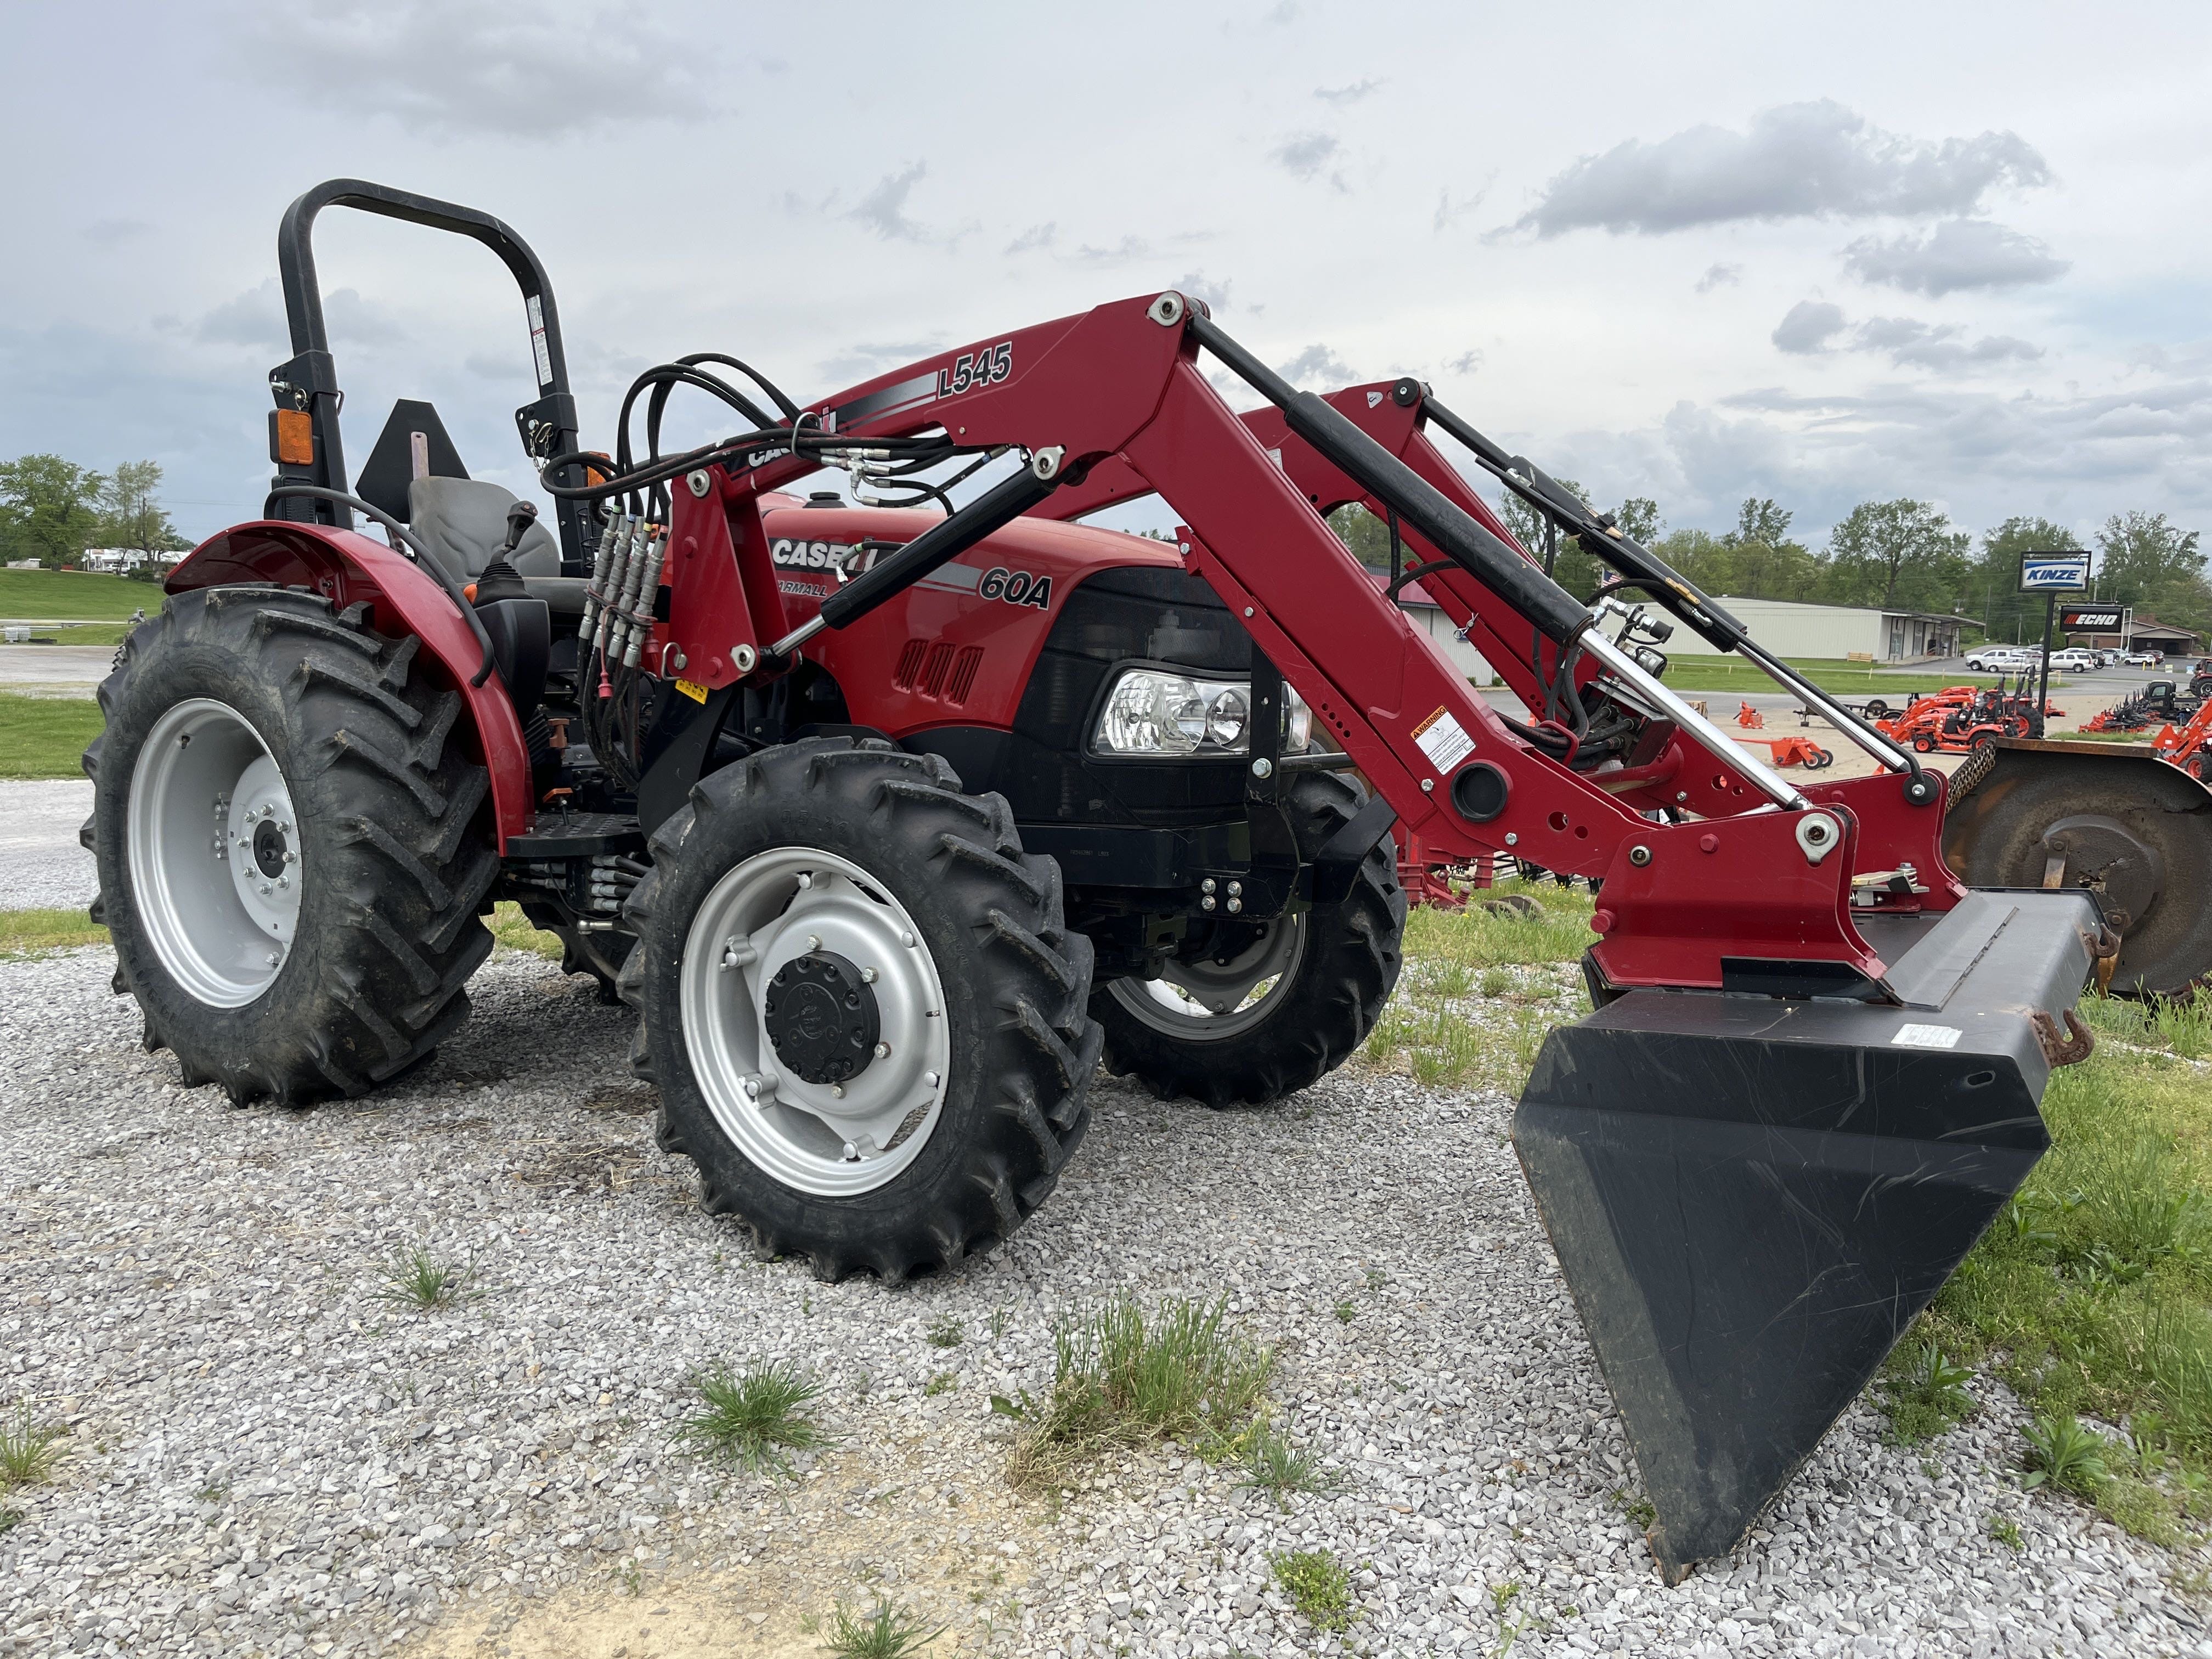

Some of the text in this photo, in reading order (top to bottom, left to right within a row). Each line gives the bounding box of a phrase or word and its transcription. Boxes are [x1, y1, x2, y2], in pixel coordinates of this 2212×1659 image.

[938, 341, 1012, 399] L545
[772, 539, 849, 569] CASE
[2027, 569, 2081, 580] KINZE
[777, 579, 828, 598] ARMALL
[979, 567, 1052, 611] 60A
[2075, 614, 2118, 626] ECHO
[1417, 707, 1446, 733] WARNING
